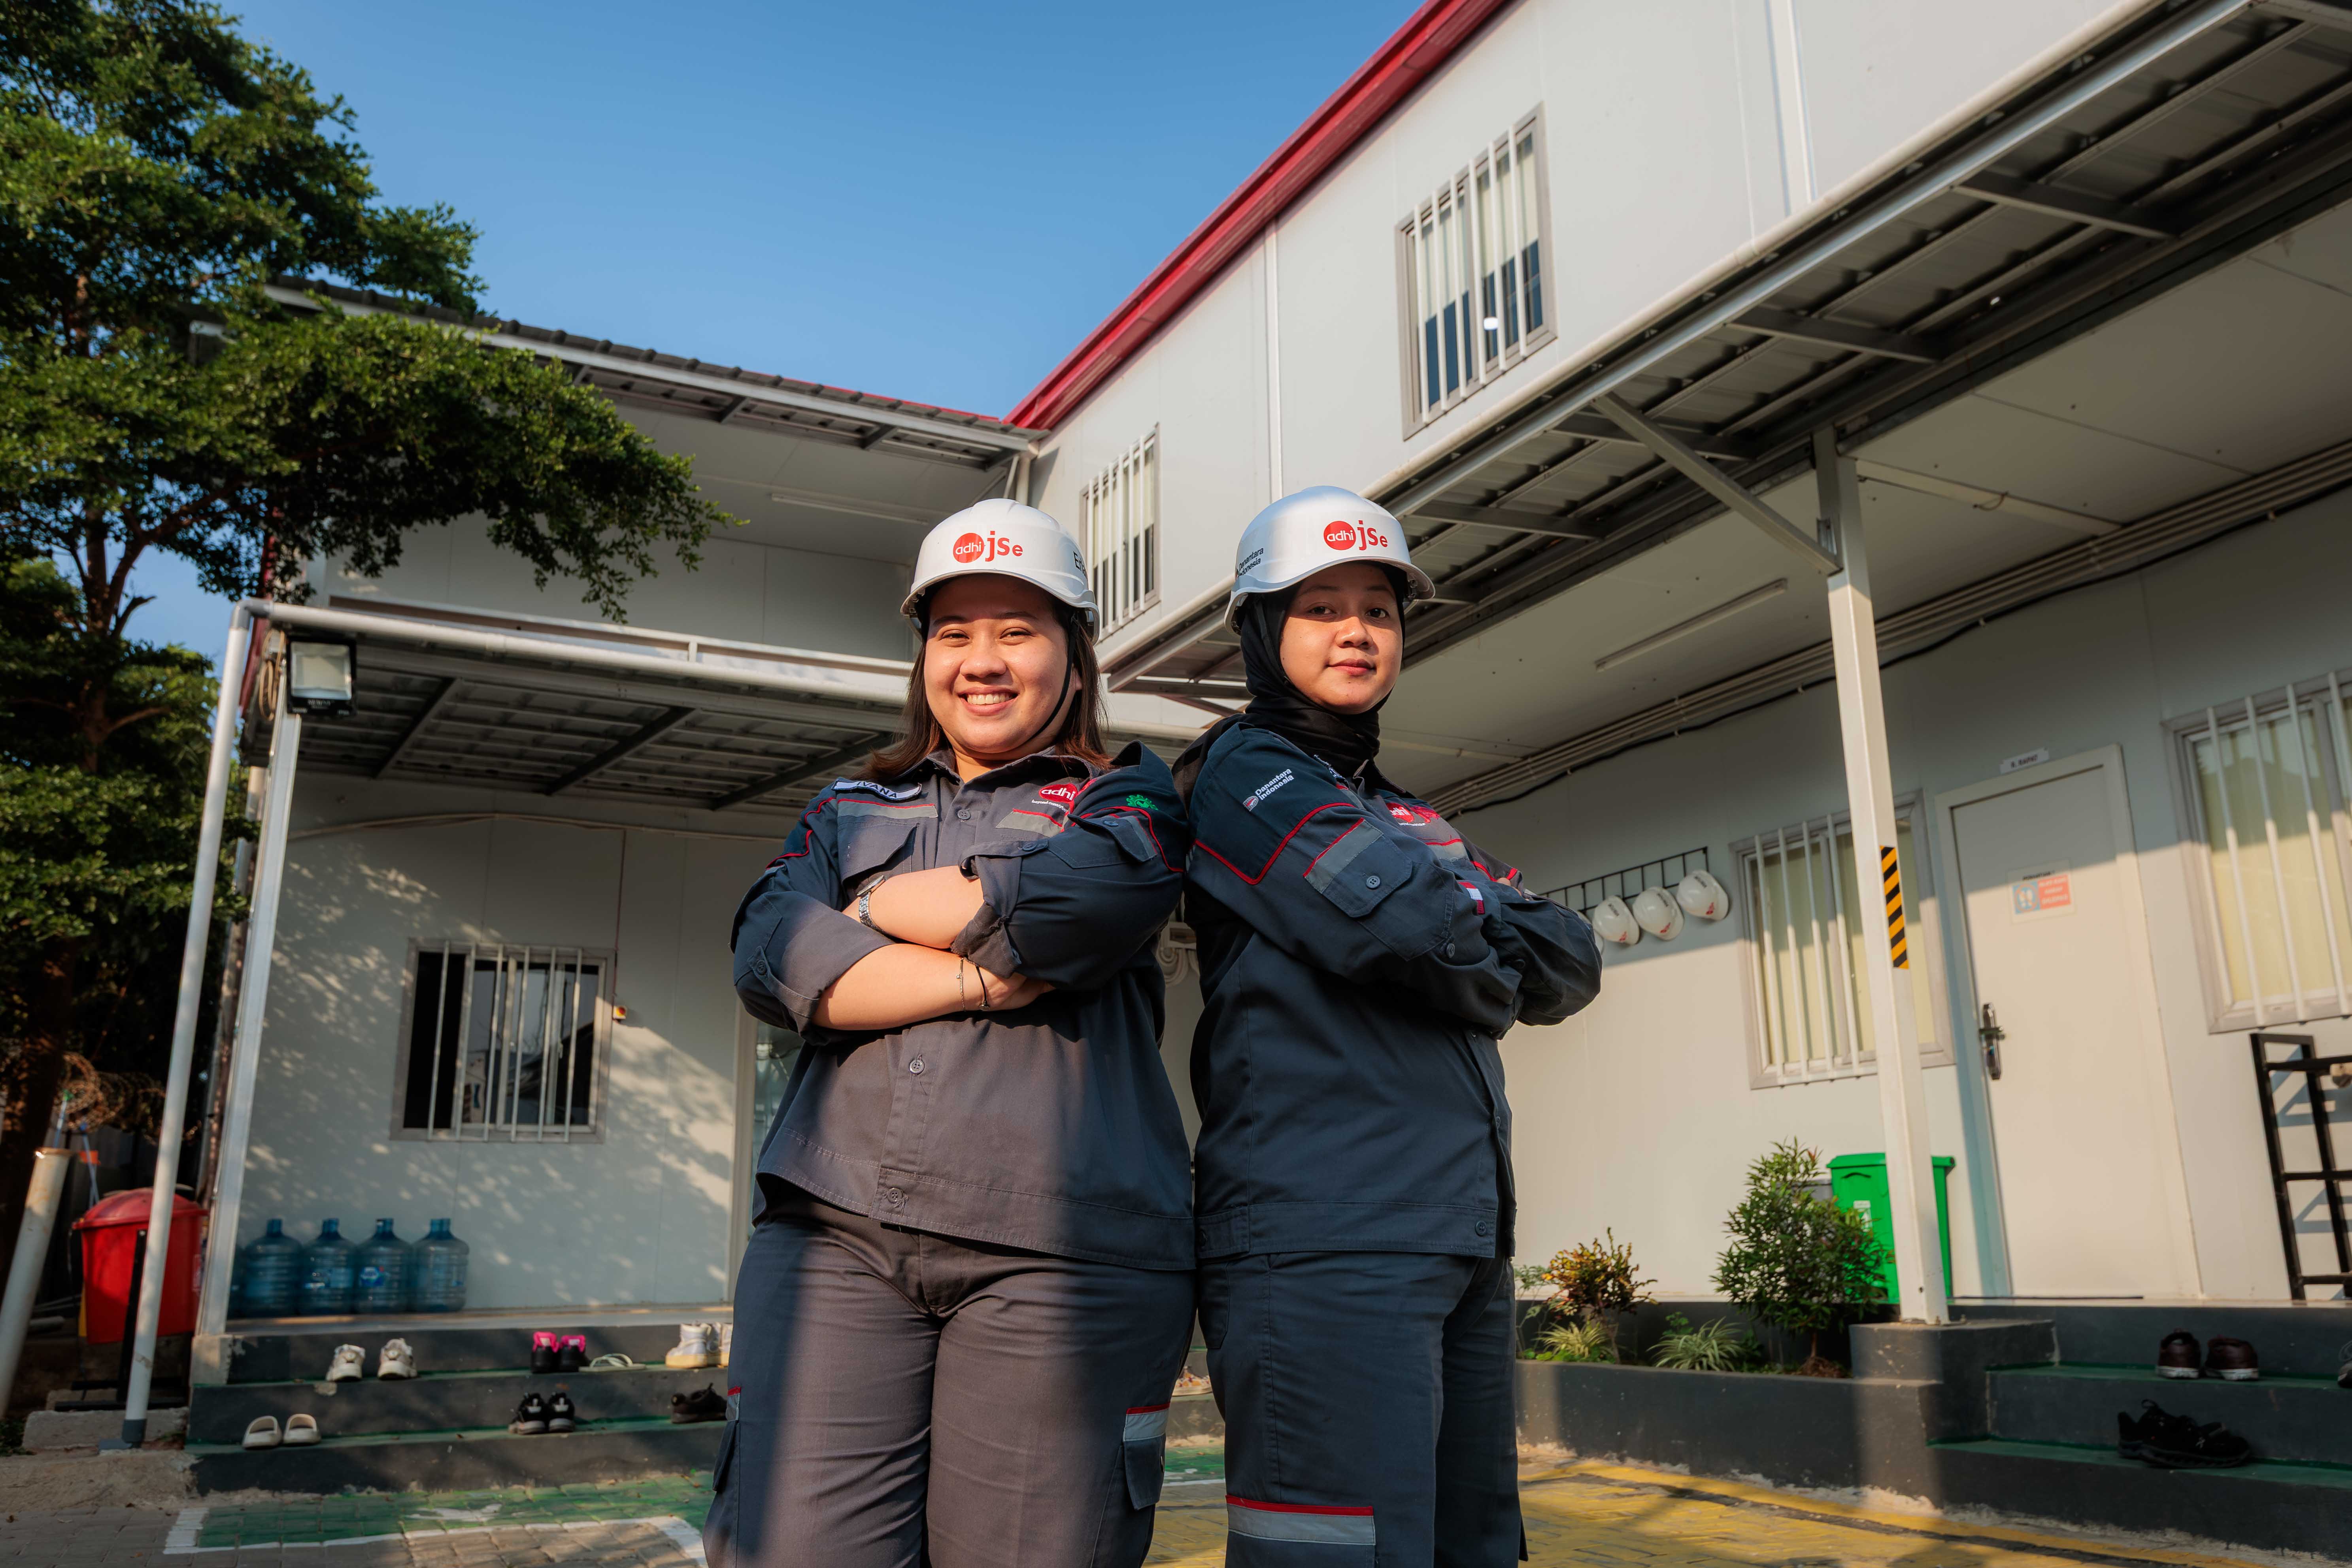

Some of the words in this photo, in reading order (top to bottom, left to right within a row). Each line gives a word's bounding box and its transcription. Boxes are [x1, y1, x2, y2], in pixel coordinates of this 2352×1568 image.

[1327, 530, 1354, 542] adhi
[955, 541, 982, 555] adhi
[1239, 548, 1264, 571] Danantara
[857, 781, 897, 798] IVANA
[1255, 769, 1292, 796] Danantara
[1258, 775, 1295, 800] Indonesia
[1041, 788, 1076, 800] adhi
